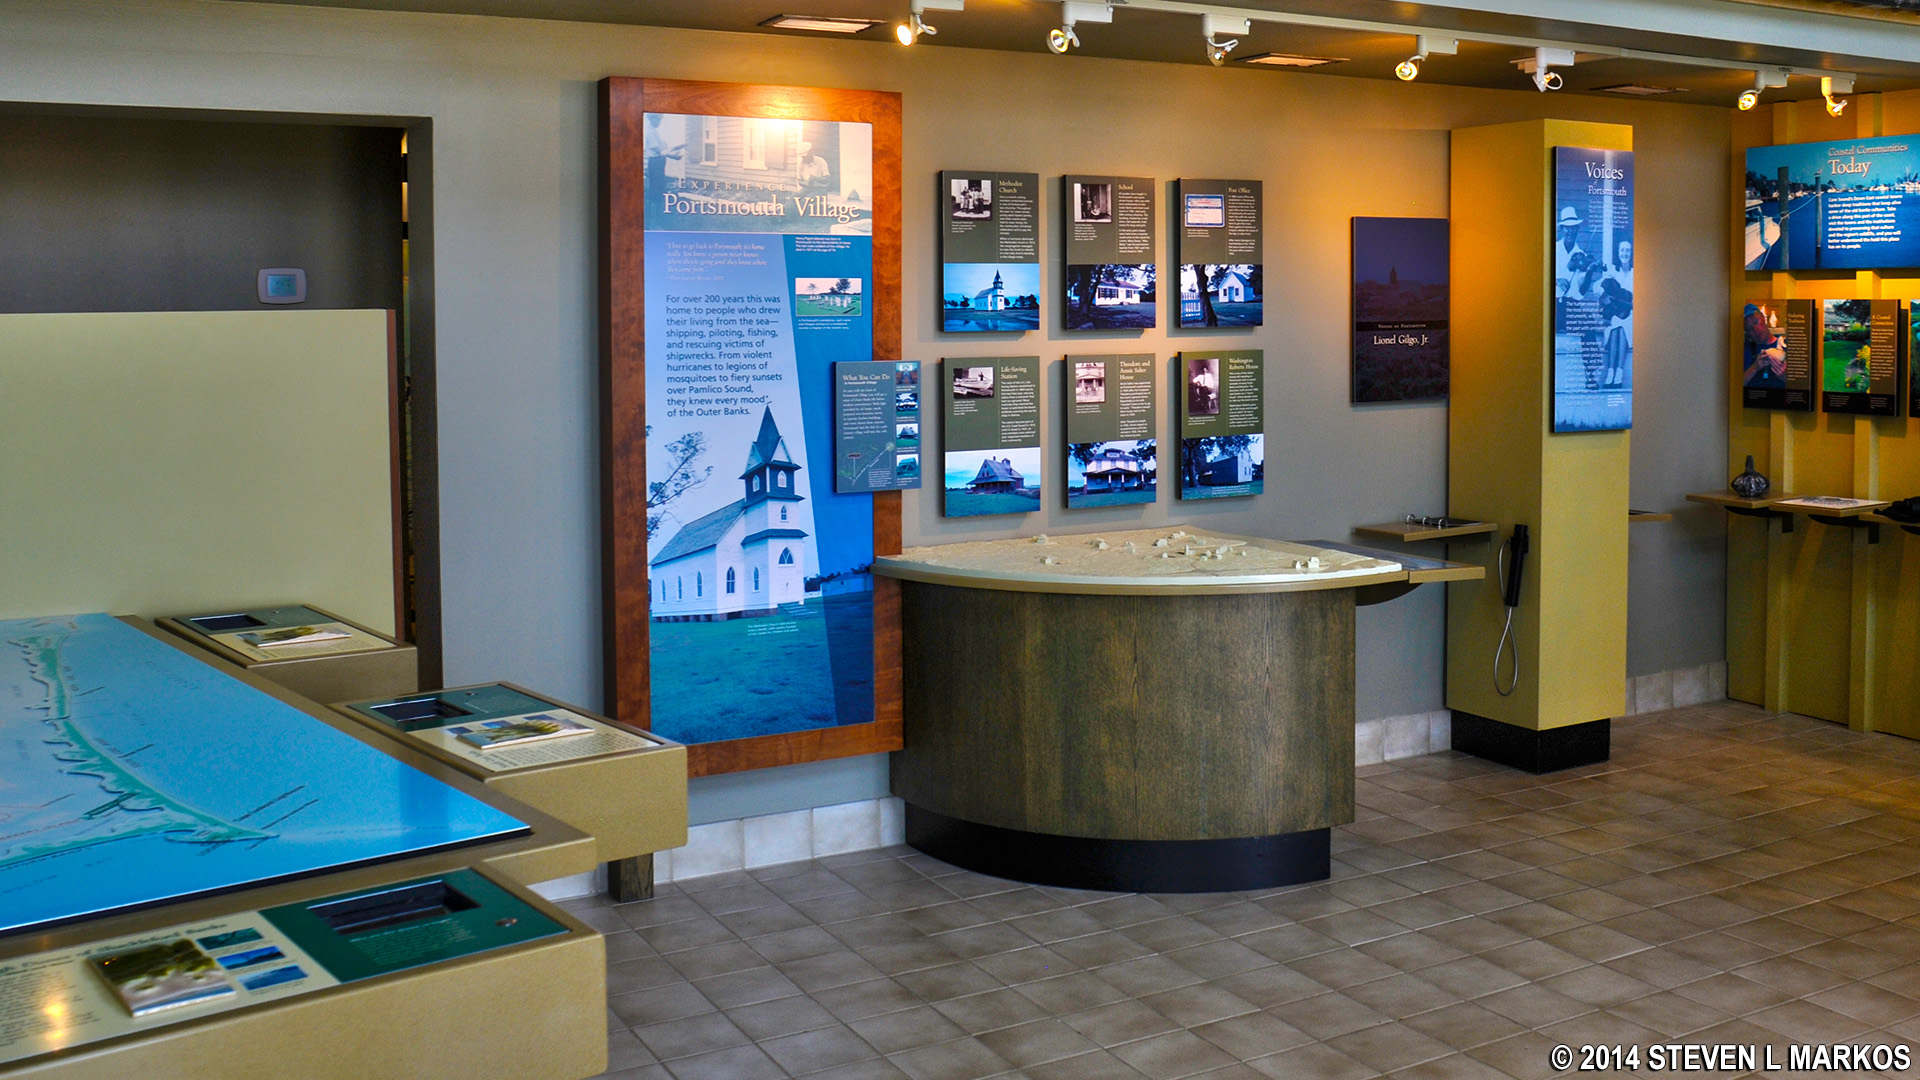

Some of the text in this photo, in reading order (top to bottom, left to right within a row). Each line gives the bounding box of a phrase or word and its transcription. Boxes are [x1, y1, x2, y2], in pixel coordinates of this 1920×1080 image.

[1828, 143, 1908, 156] Coastal Communities
[1585, 162, 1623, 179] Voices
[1828, 157, 1871, 178] Today
[1588, 186, 1626, 196] Portsmouth
[663, 193, 860, 223] Portsmouth Village
[722, 296, 744, 304] years
[706, 306, 735, 316] people
[690, 318, 713, 327] living
[716, 317, 737, 325] from
[666, 328, 778, 339] shipping, piloting, fishing,
[1374, 334, 1396, 345] Lionel
[1398, 334, 1419, 346] Gilgo,
[666, 352, 716, 361] shipwrecks.
[667, 363, 712, 371] hurricanes
[726, 362, 756, 372] legions
[759, 361, 768, 370] of
[667, 374, 716, 384] mosquitoes
[731, 373, 750, 383] fiery
[689, 385, 722, 393] Pamlico
[725, 384, 753, 393] Sound,
[667, 398, 686, 407] they
[715, 398, 738, 406] every
[667, 409, 676, 417] of
[696, 408, 722, 416] Outer
[724, 407, 751, 415] Banks.
